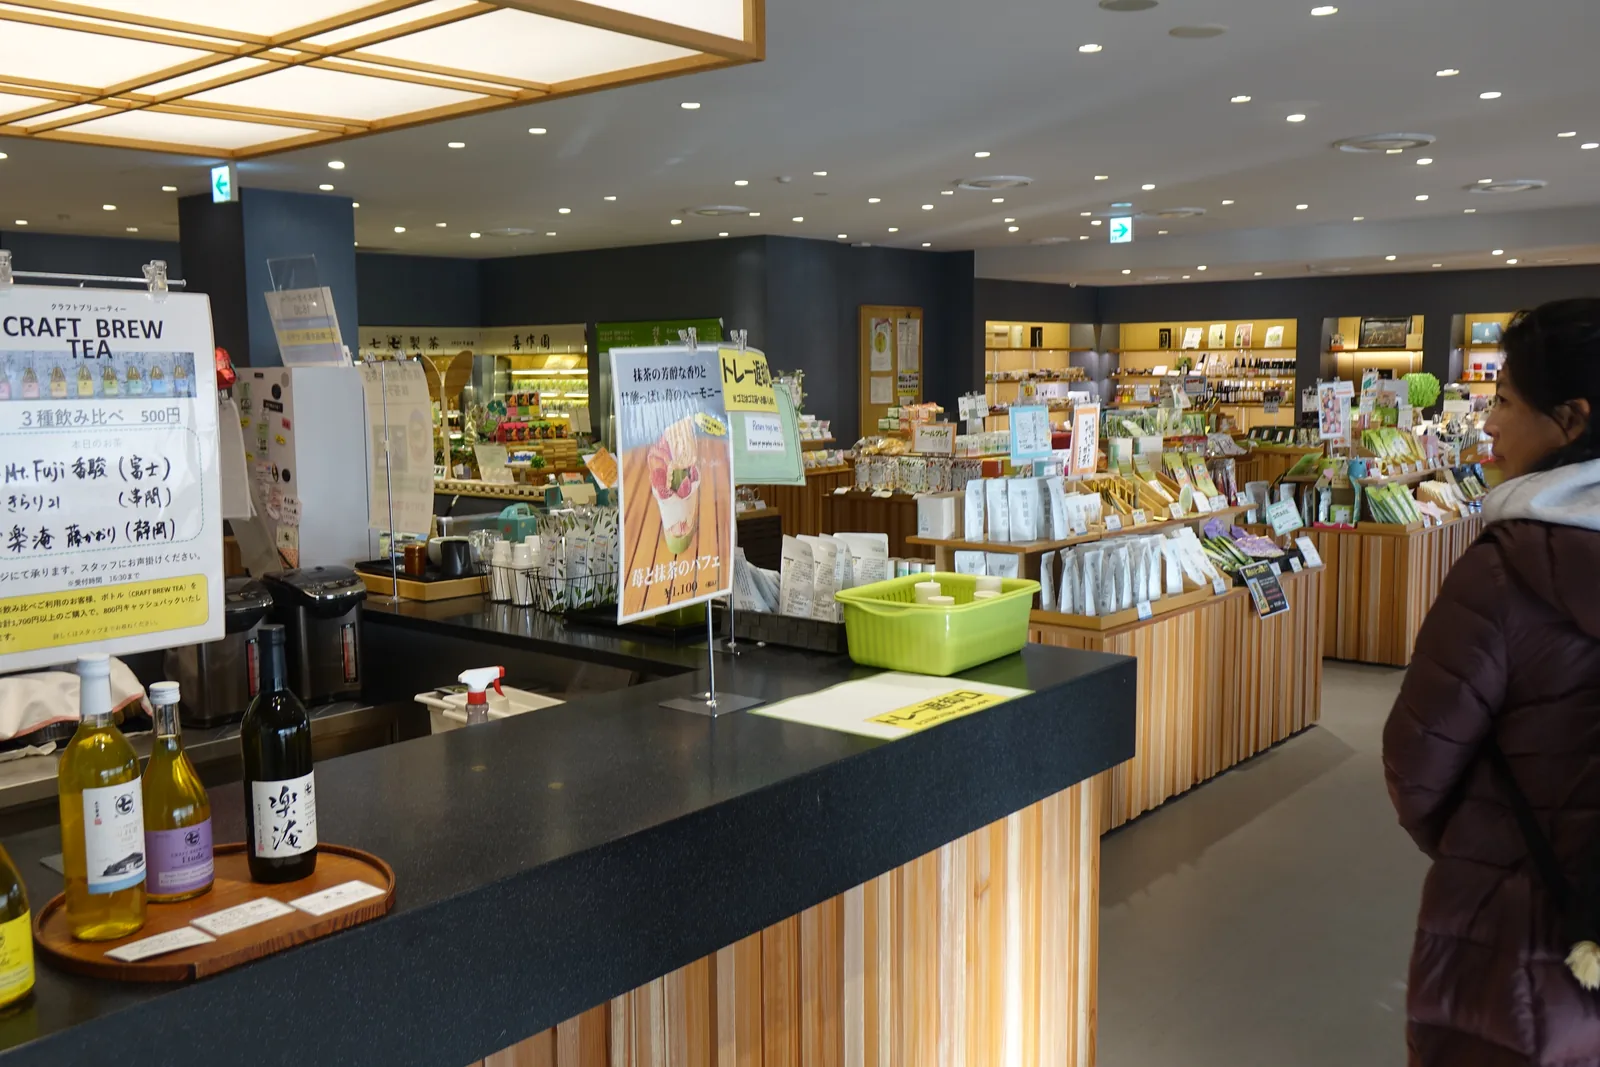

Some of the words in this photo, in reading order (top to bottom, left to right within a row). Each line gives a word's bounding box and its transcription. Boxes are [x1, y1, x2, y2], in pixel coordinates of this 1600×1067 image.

[51, 303, 127, 312] クラフトブリューティー
[3, 315, 82, 338] CRAFT
[95, 319, 163, 339] BREW
[67, 339, 113, 359] TEA
[633, 365, 707, 383] 抹茶の芳醇な香りと
[21, 408, 124, 427] 3種飲み比べ
[141, 407, 181, 423] 500円
[33, 460, 65, 482] Fuji
[125, 519, 175, 544] (静岡)
[632, 554, 720, 587] 苺と抹茶のパフェ
[664, 581, 698, 599] ¥1,100
